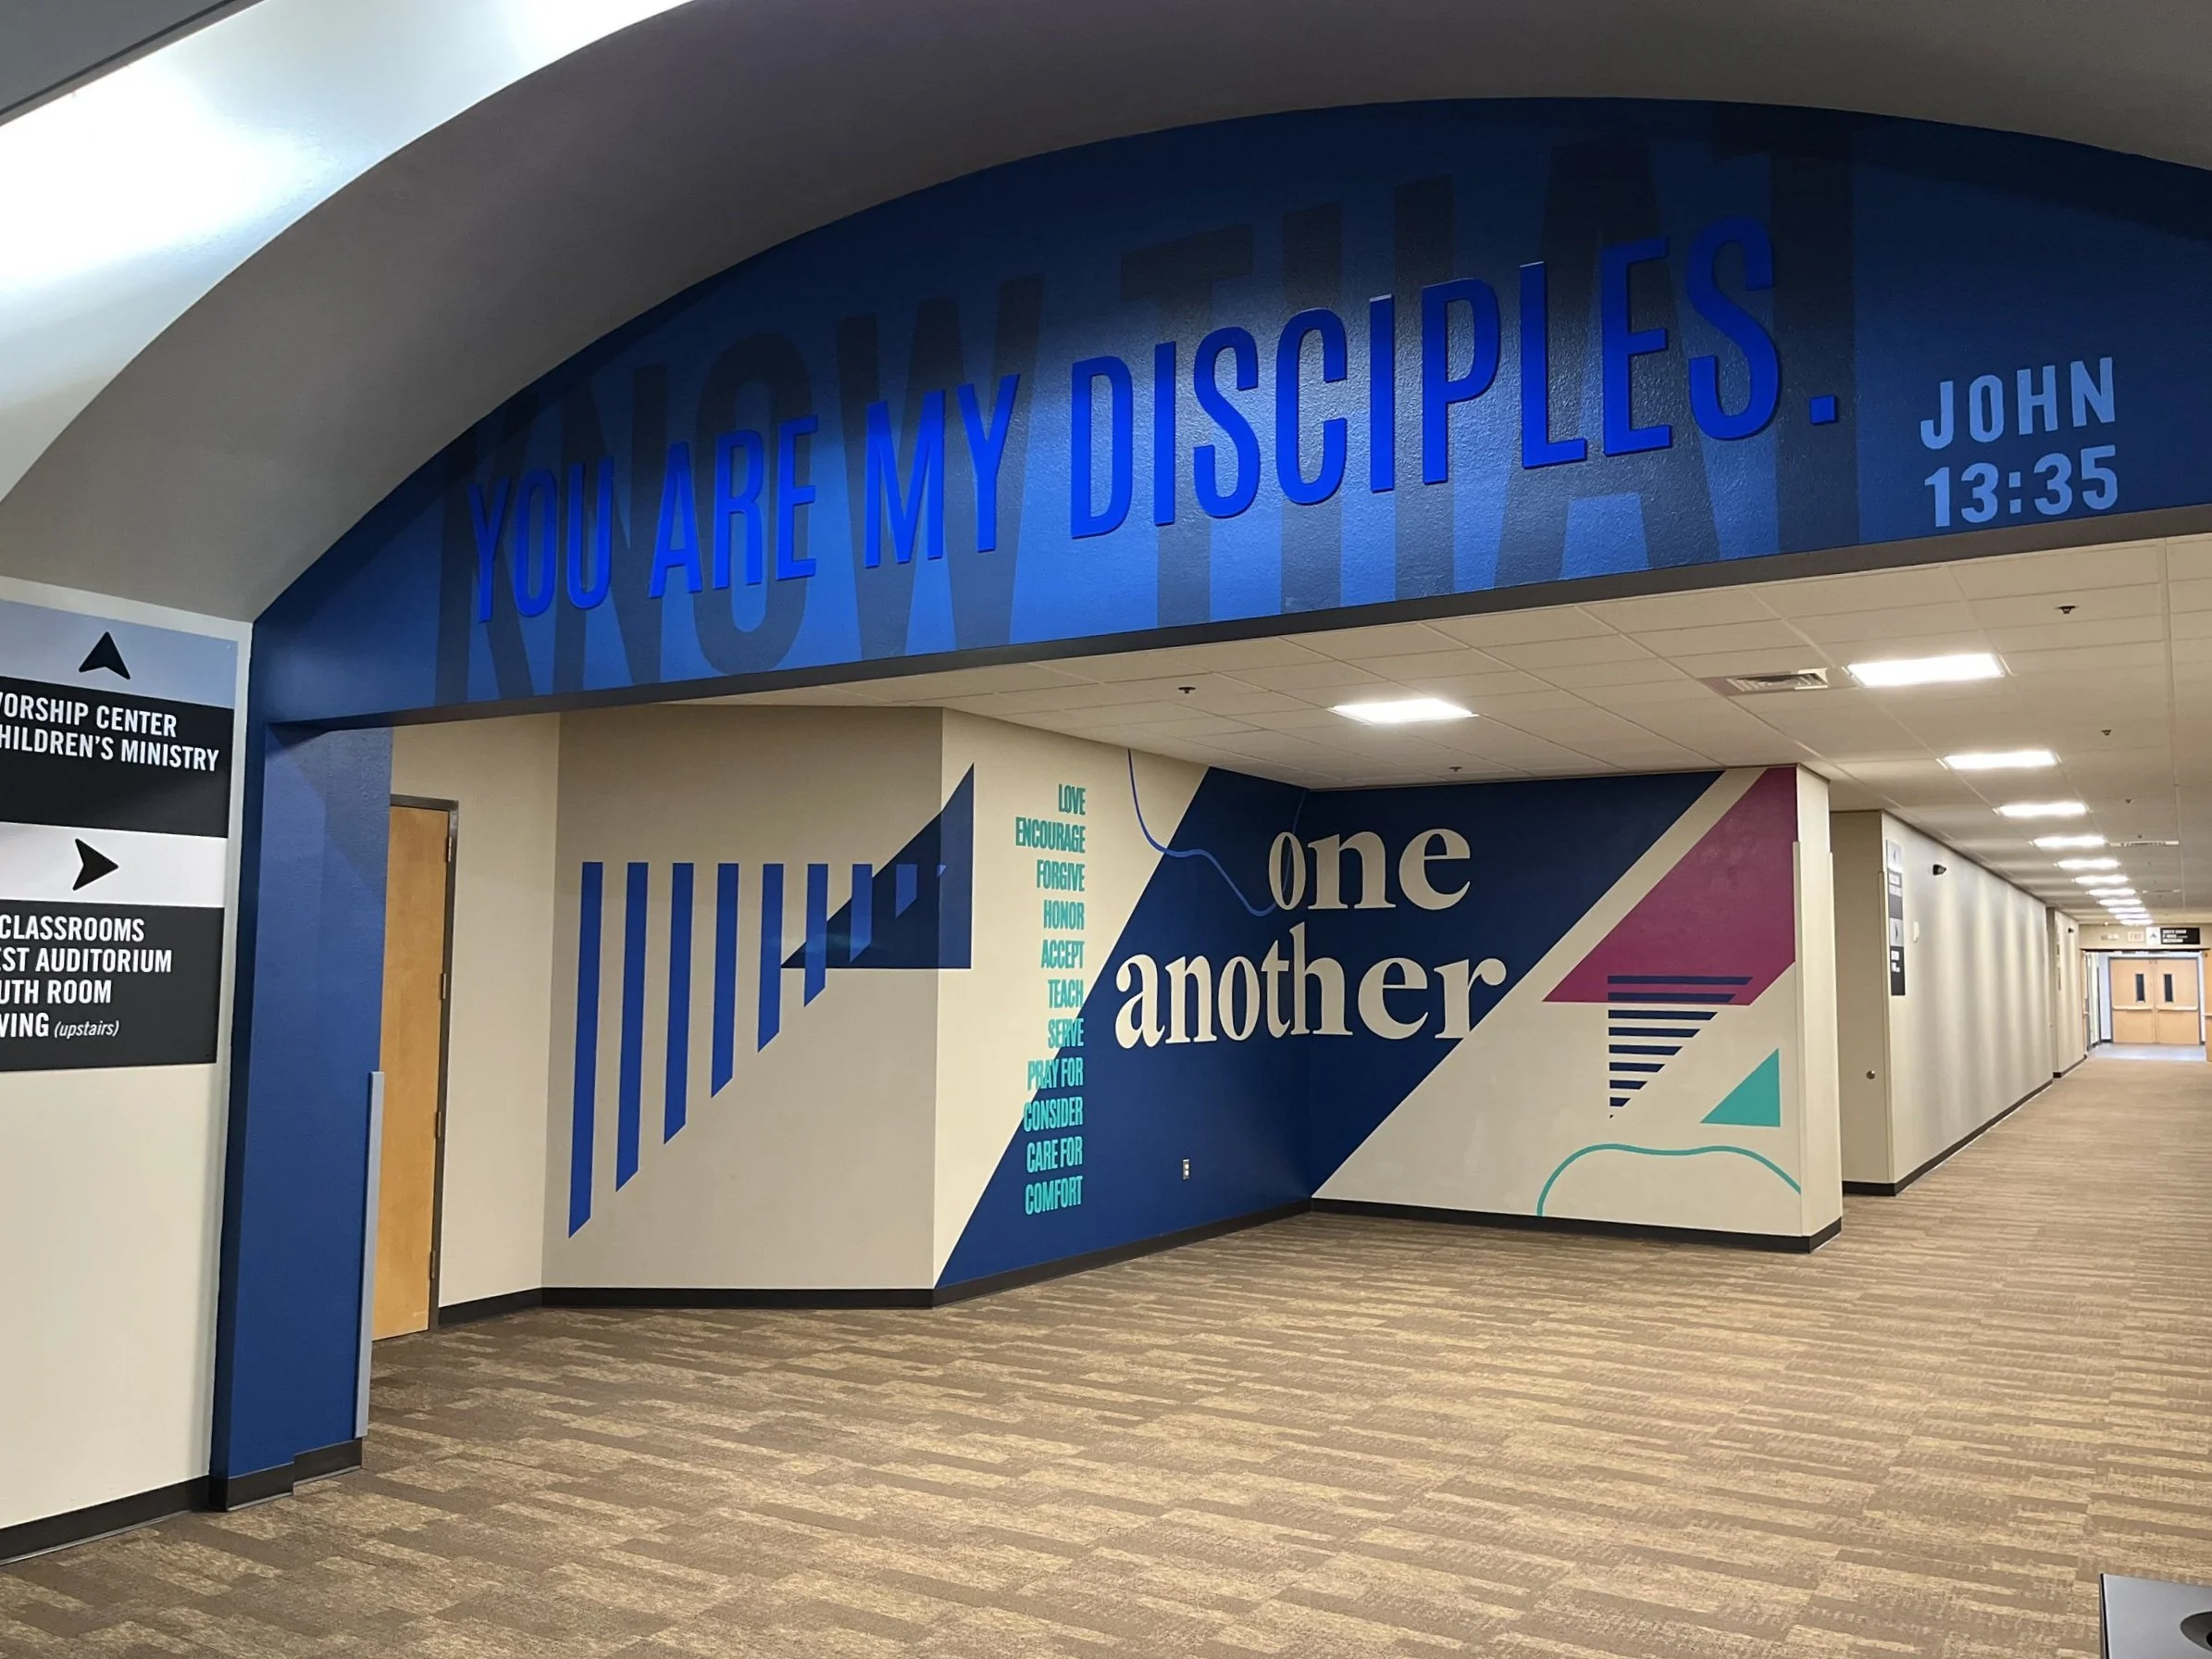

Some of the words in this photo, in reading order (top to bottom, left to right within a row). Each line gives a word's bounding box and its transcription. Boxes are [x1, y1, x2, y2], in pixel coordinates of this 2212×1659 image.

[433, 271, 1044, 701] KNOW
[1121, 100, 1861, 630] THAT
[1920, 357, 2115, 449] JOHN
[469, 456, 614, 623] YOU
[650, 415, 818, 598] ARE
[864, 374, 1020, 568] MY
[1071, 217, 1838, 539] DISCIPLES.
[1924, 444, 2118, 527] 13:35
[96, 705, 177, 738] CENTER
[121, 739, 219, 771] MINISTRY
[1058, 783, 1086, 815] LOVE
[1015, 817, 1086, 854] ENCOURAGE
[1037, 859, 1086, 892] FORGIVE
[1269, 829, 1471, 910] one
[0, 915, 145, 942] CLASSROOMS
[1043, 899, 1085, 930] HONOR
[0, 947, 30, 972] ST
[35, 948, 172, 972] AUDITORIUM
[1041, 940, 1085, 969] ACCEPT
[47, 979, 112, 1004] ROOM
[1048, 979, 1084, 1009] TEACH
[1115, 921, 1507, 1048] another
[54, 1020, 119, 1040] (upstairs)
[1048, 1018, 1084, 1048] SERVE
[1027, 1058, 1060, 1091] PRAY
[1062, 1057, 1084, 1087] FOR
[1024, 1097, 1084, 1132] CONSIDER
[1026, 1139, 1058, 1173] CARE
[1061, 1136, 1083, 1167] FOR
[1025, 1176, 1083, 1216] COMFORT
